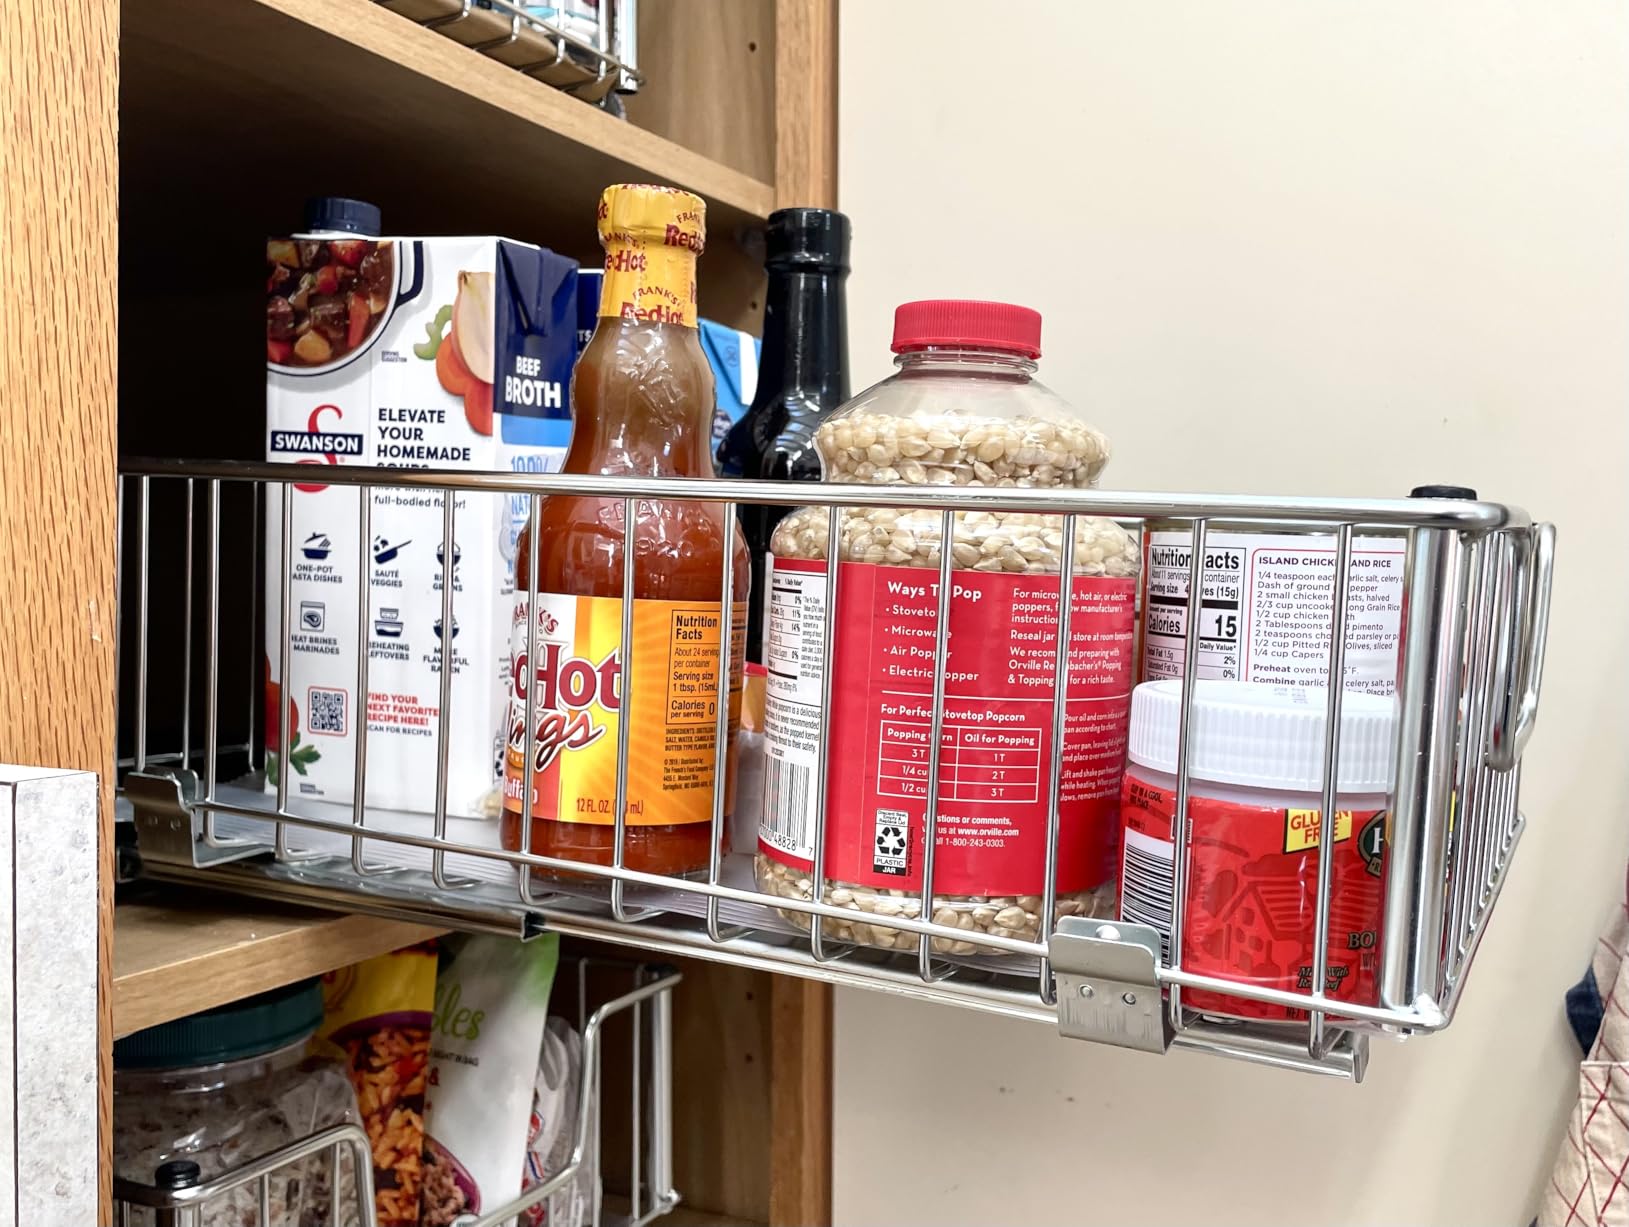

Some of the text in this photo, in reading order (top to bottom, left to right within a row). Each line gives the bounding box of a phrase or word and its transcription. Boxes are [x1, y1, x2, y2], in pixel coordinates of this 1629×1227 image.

[605, 250, 647, 273] edHot
[632, 286, 678, 305] FRANK'S
[516, 356, 541, 377] BEEF
[505, 377, 561, 408] BROTH
[378, 408, 446, 424] ELEVATE
[378, 426, 424, 441] YOUR
[275, 433, 359, 453] SWANSON
[377, 445, 471, 461] HOMEMADE
[374, 496, 432, 508] full-bodied
[1205, 551, 1240, 569] acts
[1259, 556, 1391, 568] ISLAND AND RICE
[296, 564, 333, 574] ONE-POT
[375, 569, 400, 579] SAUTÉ
[292, 573, 343, 584] ASTA DISHES
[1167, 570, 1240, 584] servings container
[1258, 571, 1399, 584] 1/4 teaspoon salt, celery
[371, 578, 403, 588] VEGGIES
[1258, 581, 1378, 593] Dash of ground pepper
[887, 581, 982, 602] Ways Pop
[1013, 588, 1029, 599] For
[1080, 590, 1092, 600] hot
[1166, 584, 1239, 599] size (15g)
[1265, 591, 1390, 602] small chicken halved
[892, 605, 936, 617] Stoveto
[1012, 602, 1053, 613] poppers,
[1257, 600, 1273, 609] 2/3
[1276, 602, 1293, 611] cup
[1256, 610, 1329, 620] 1/2 cup chicken
[676, 615, 718, 627] Nutrition
[1149, 614, 1237, 637] Calories 15
[1265, 620, 1384, 631] Tablespoons pimento
[676, 628, 703, 640] Facts
[1010, 629, 1041, 640] Reseal
[1042, 630, 1055, 643] jar
[1073, 631, 1092, 641] store
[1264, 630, 1383, 641] teaspoons parsley
[309, 636, 338, 646] BRINES
[1200, 641, 1215, 651] Daily
[1255, 639, 1393, 650] 1/2 cup Pitted Olives, sliced
[293, 645, 340, 655] MARINADES
[674, 647, 692, 657] About
[890, 645, 907, 655] Air
[1010, 646, 1026, 657] We
[1079, 650, 1109, 660] preparing
[1254, 648, 1324, 659] 1/4 cup Capers
[673, 659, 711, 669] per container
[1009, 660, 1041, 670] Orville
[1224, 655, 1236, 665] 2%
[889, 665, 979, 682] Electric opper
[1223, 669, 1235, 679] 0%
[1253, 664, 1291, 673] Preheat
[673, 672, 714, 682] Serving size
[1007, 673, 1099, 687] & Topping for rich
[1253, 676, 1296, 686] Combine
[1345, 680, 1369, 688] celery
[1371, 680, 1385, 688] salt,
[679, 683, 697, 694] tbsp.
[391, 694, 418, 704] YOUR
[367, 702, 439, 717] NEXT FAVORITE
[671, 700, 715, 716] Calories 0
[881, 704, 897, 715] For
[899, 705, 932, 718] Perfec
[986, 711, 1025, 723] Popcorn
[670, 710, 704, 719] per serving
[1087, 712, 1096, 721] and
[400, 715, 429, 726] HERE!
[386, 726, 432, 737] FOR RECIPES
[1075, 723, 1100, 734] according
[887, 728, 1035, 746] Popping Oil for Popping
[1063, 742, 1080, 750] Cover
[911, 748, 918, 758] 3
[902, 765, 1006, 780] 1/4 2 T
[1072, 769, 1083, 778] and
[901, 783, 1005, 797] 1/2 3 T
[577, 798, 585, 812] 12
[962, 815, 1012, 826] or comments,
[958, 827, 1019, 837] www.orville.com
[945, 837, 1006, 848] 1-800-243-0303.
[877, 858, 904, 867] PLASTIC
[882, 866, 896, 875] JAR
